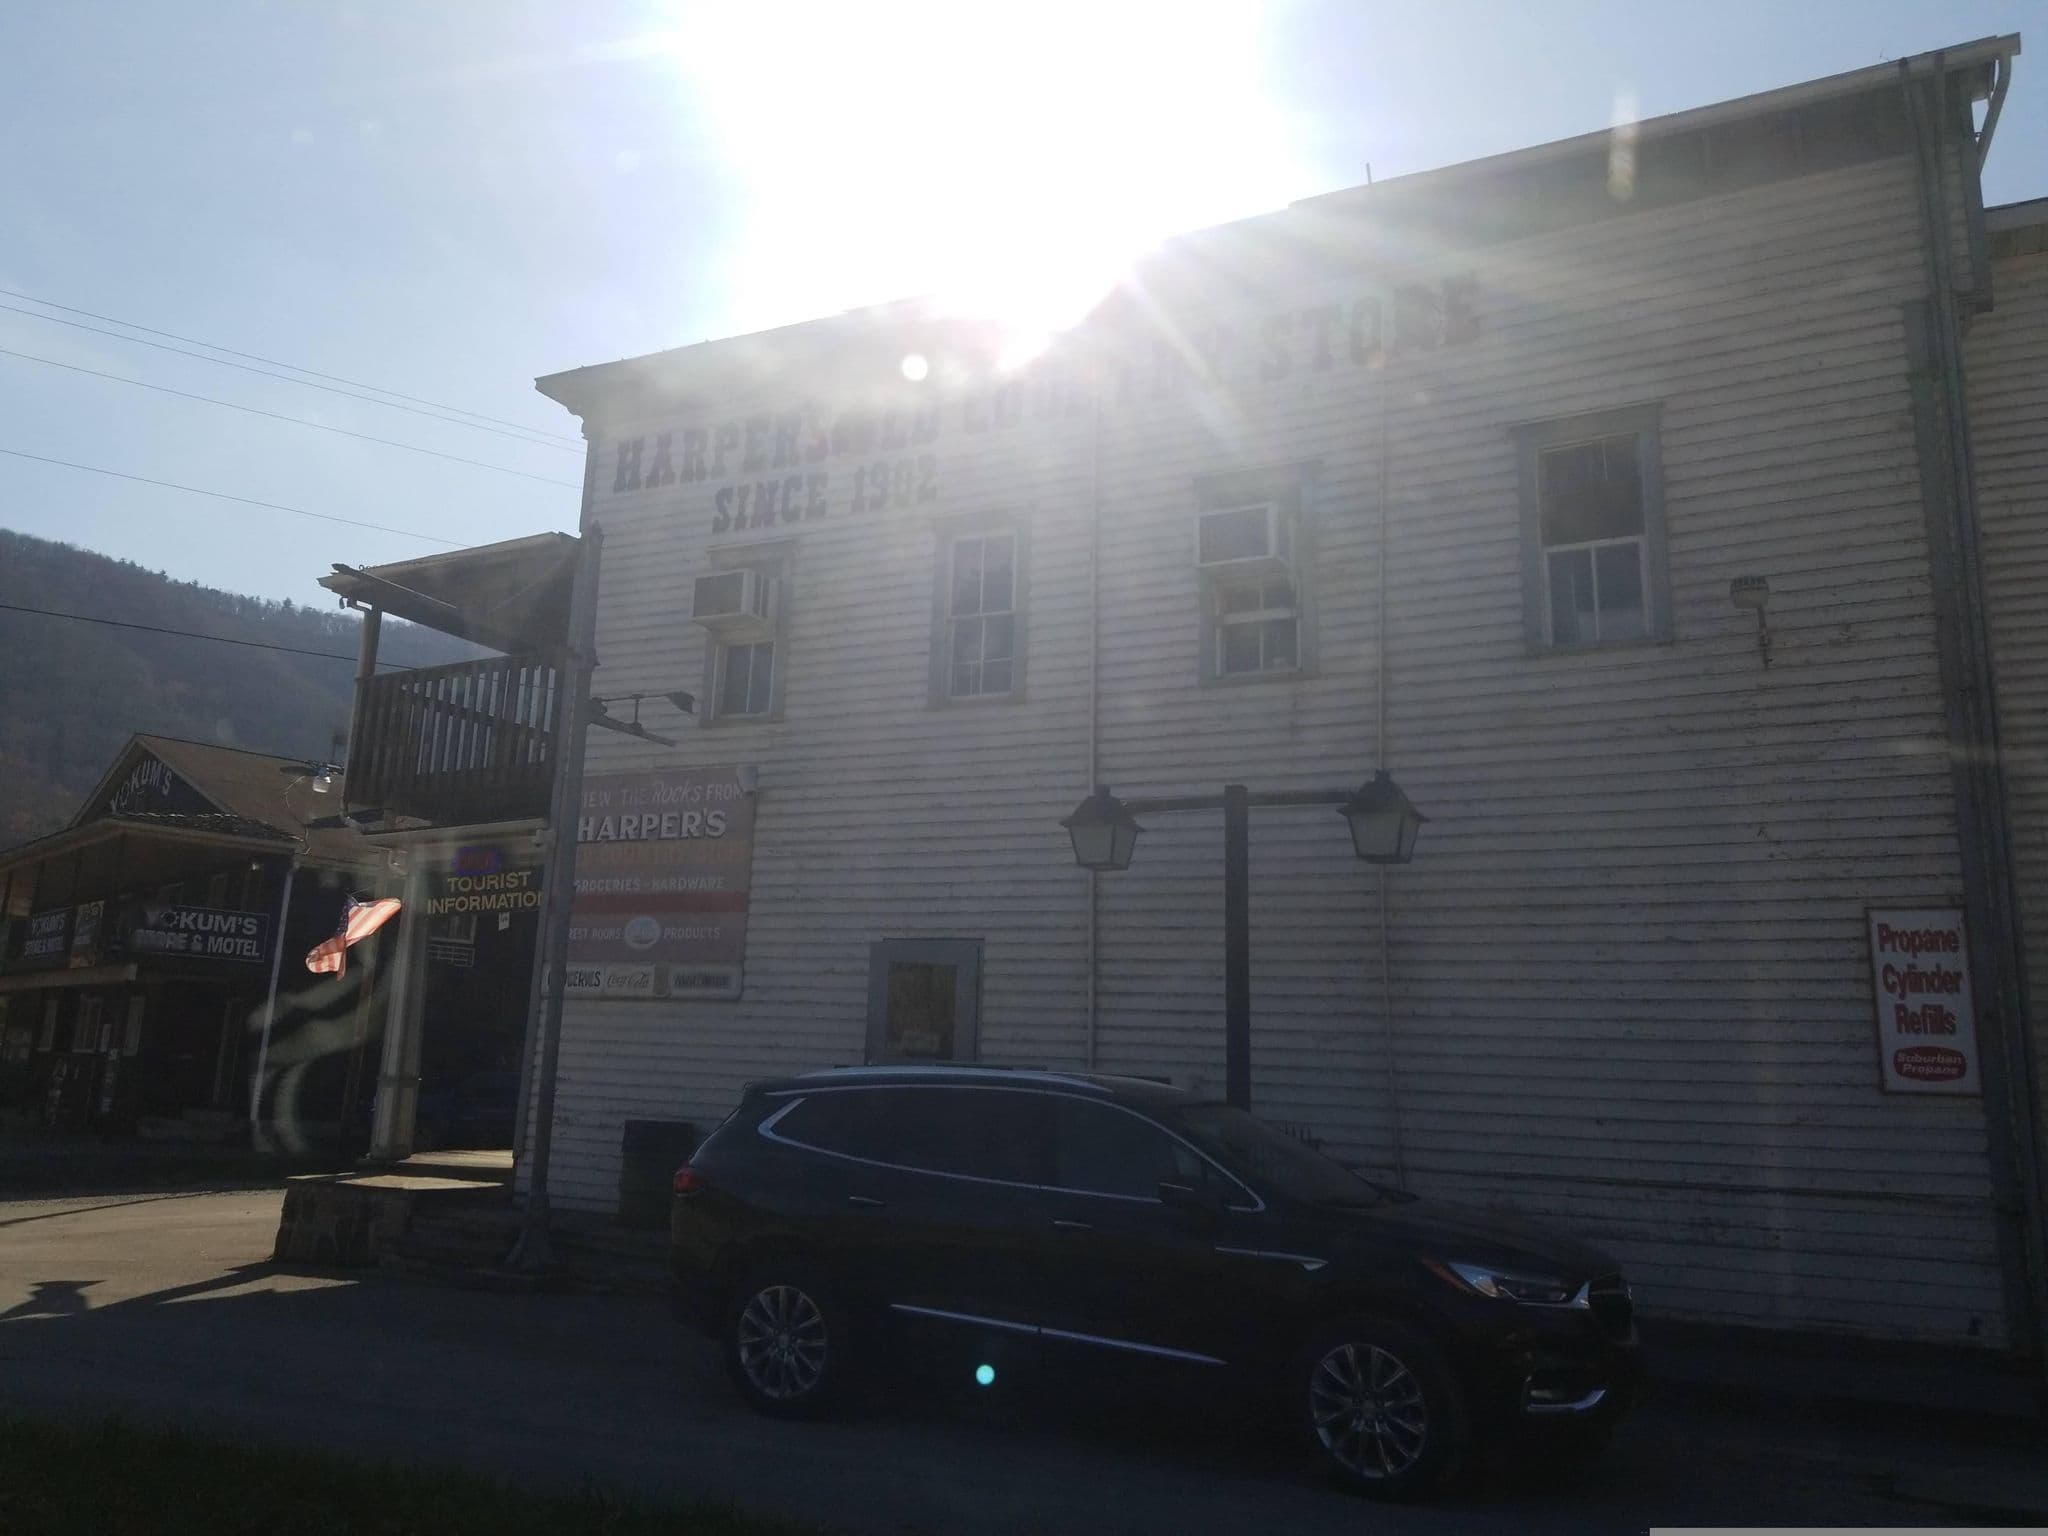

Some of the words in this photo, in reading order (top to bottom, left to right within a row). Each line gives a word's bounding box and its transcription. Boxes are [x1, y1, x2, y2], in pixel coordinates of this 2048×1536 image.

[1257, 270, 1482, 382] STORE
[712, 471, 829, 534] SINCE
[852, 453, 938, 514] 1902
[577, 808, 728, 842] HARPER'S
[447, 871, 532, 893] TOURIST
[652, 875, 726, 892] HARDWARE
[207, 935, 260, 957] MOTEL
[663, 926, 721, 940] PRODUCTS
[1877, 922, 1960, 958] Propane
[1882, 962, 1962, 1000] Cylinder
[1894, 1003, 1957, 1034] Refills
[1896, 1053, 1963, 1064] Suburban
[1902, 1063, 1960, 1075] Propane
